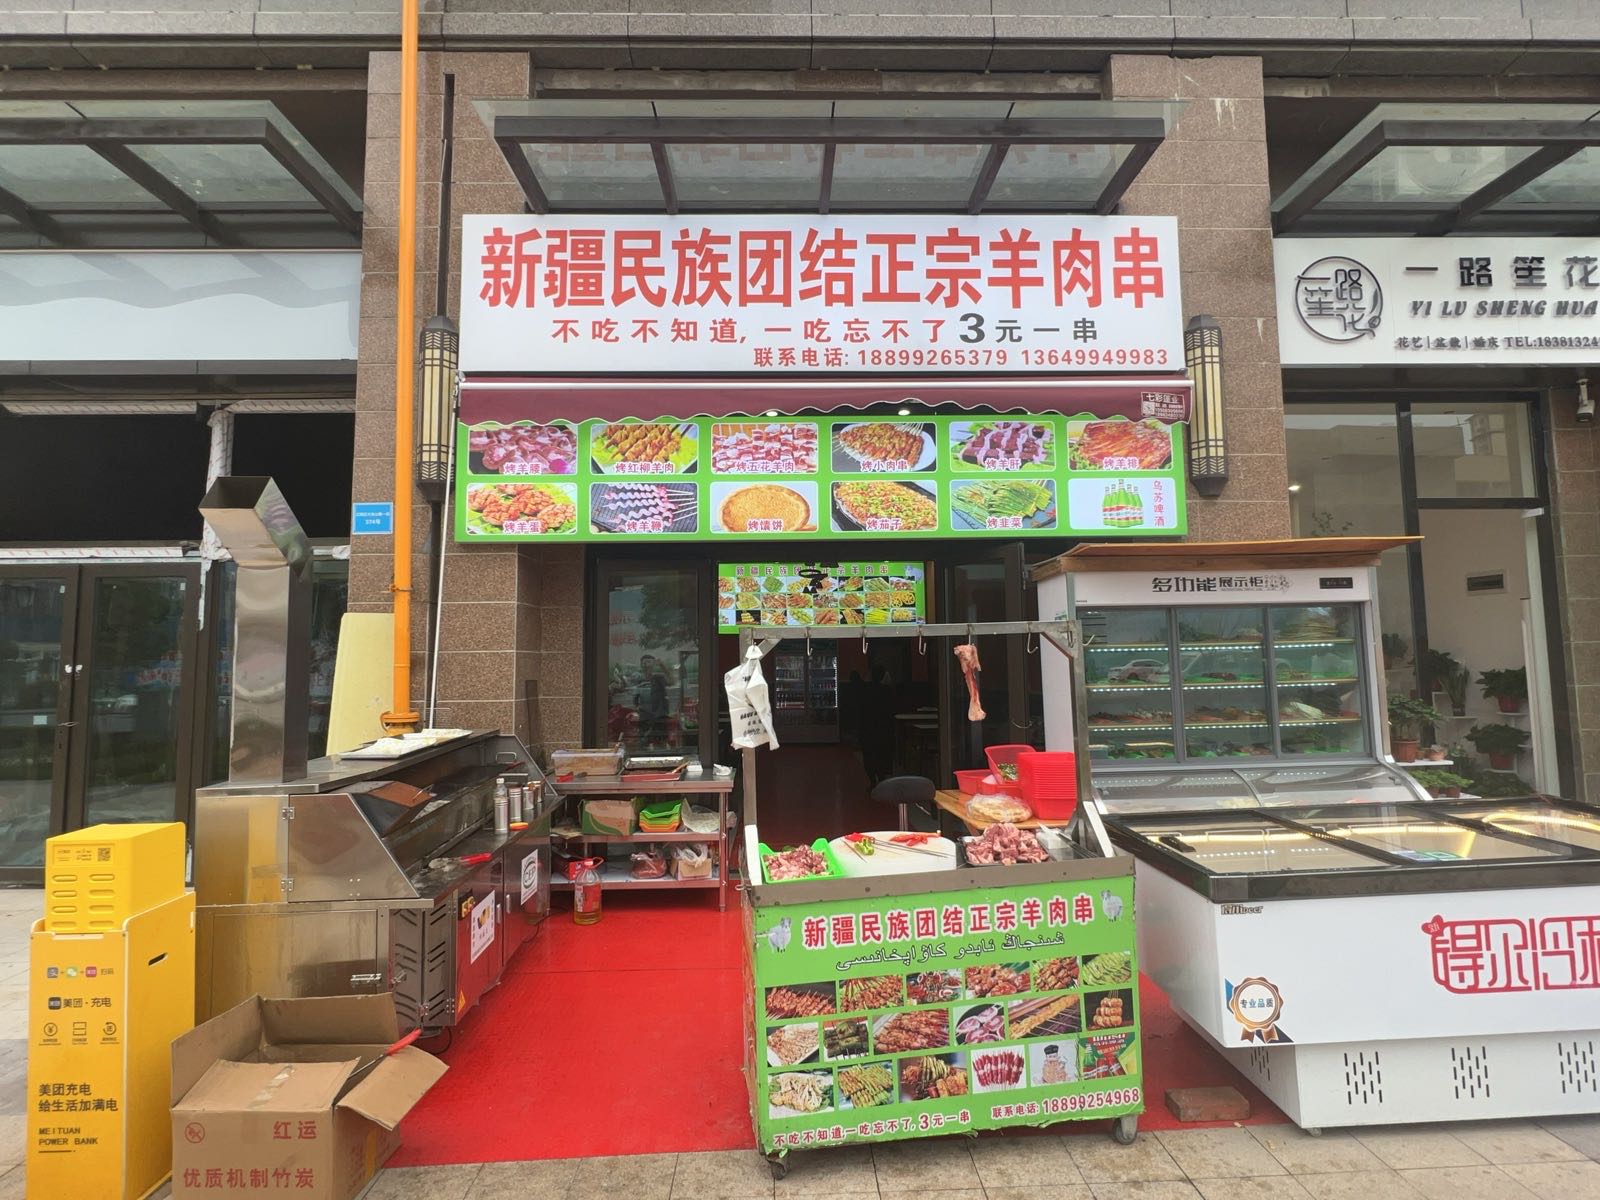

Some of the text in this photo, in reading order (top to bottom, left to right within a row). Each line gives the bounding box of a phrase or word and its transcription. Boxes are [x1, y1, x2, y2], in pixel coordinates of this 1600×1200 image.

[479, 226, 1165, 309] 新疆民族团结正宗羊肉串
[1411, 299, 1599, 316] YI LU SHENG HUA
[1504, 336, 1600, 348] TEL:18381324
[857, 348, 1008, 367] 18899265379
[1021, 347, 1168, 366] 13649949983
[504, 462, 542, 475] 烤羊腰
[614, 462, 675, 474] 烤红柳羊肉
[735, 461, 795, 473] 烤五花羊肉
[861, 460, 909, 472] 烤小肉串
[985, 458, 1021, 470] 烤羊肝
[1102, 457, 1138, 469] 烤羊排
[1152, 479, 1165, 527] 乌苏啤酒
[502, 520, 542, 533] 烤羊蛋
[625, 520, 662, 532] 烤羊鞭
[865, 518, 903, 531] 烤茄子
[986, 516, 1023, 529] 烤韭菜
[803, 895, 1094, 947] 新疆民族团结正宗羊肉串
[1240, 998, 1274, 1008] 专业品质
[38, 1083, 92, 1097] 美团充电
[38, 1098, 119, 1112] 给生活加满电
[1042, 1088, 1140, 1113] 18899254968
[38, 1127, 81, 1135] MEITUAN
[272, 1119, 318, 1140] 红运
[38, 1136, 98, 1146] POWER BANK
[183, 1166, 315, 1189] 优质机制竹炭
